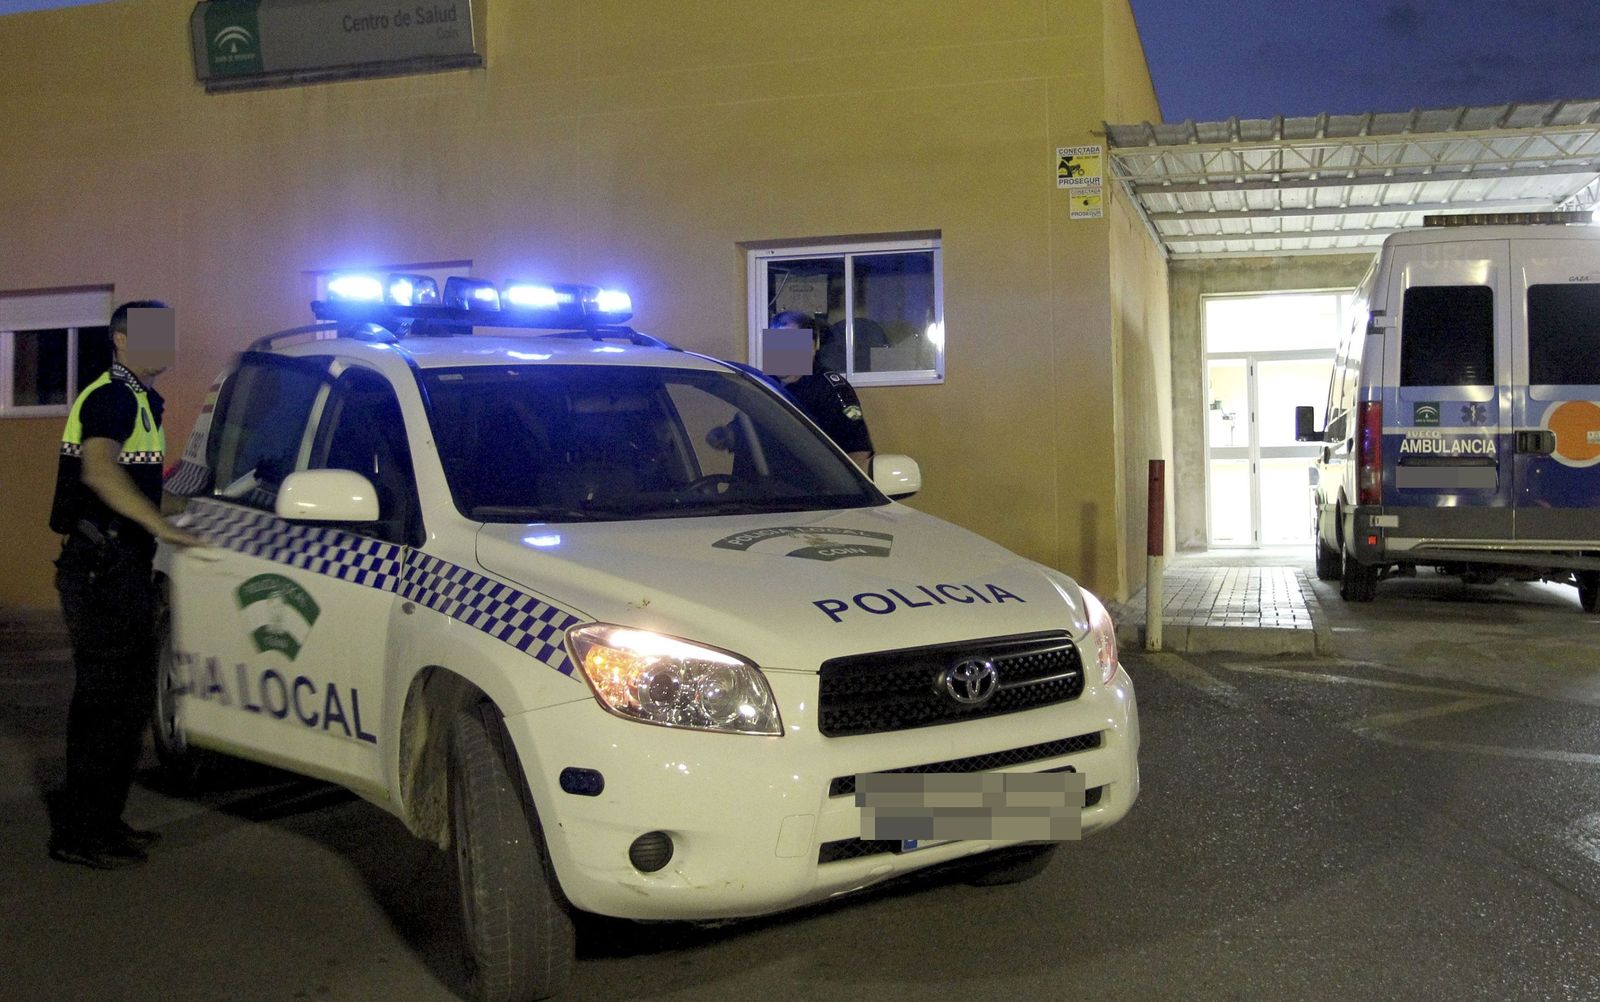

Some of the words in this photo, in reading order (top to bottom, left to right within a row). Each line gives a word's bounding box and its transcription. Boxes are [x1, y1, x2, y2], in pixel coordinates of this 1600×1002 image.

[341, 14, 389, 33] Centro
[394, 10, 411, 27] de
[416, 6, 458, 26] Salud
[1058, 147, 1100, 155] CONECTADA
[1058, 177, 1100, 185] PROSEGUR
[1400, 439, 1496, 453] AMBULANCIA
[812, 583, 1027, 624] POLICIA
[236, 662, 377, 745] LOCAL
